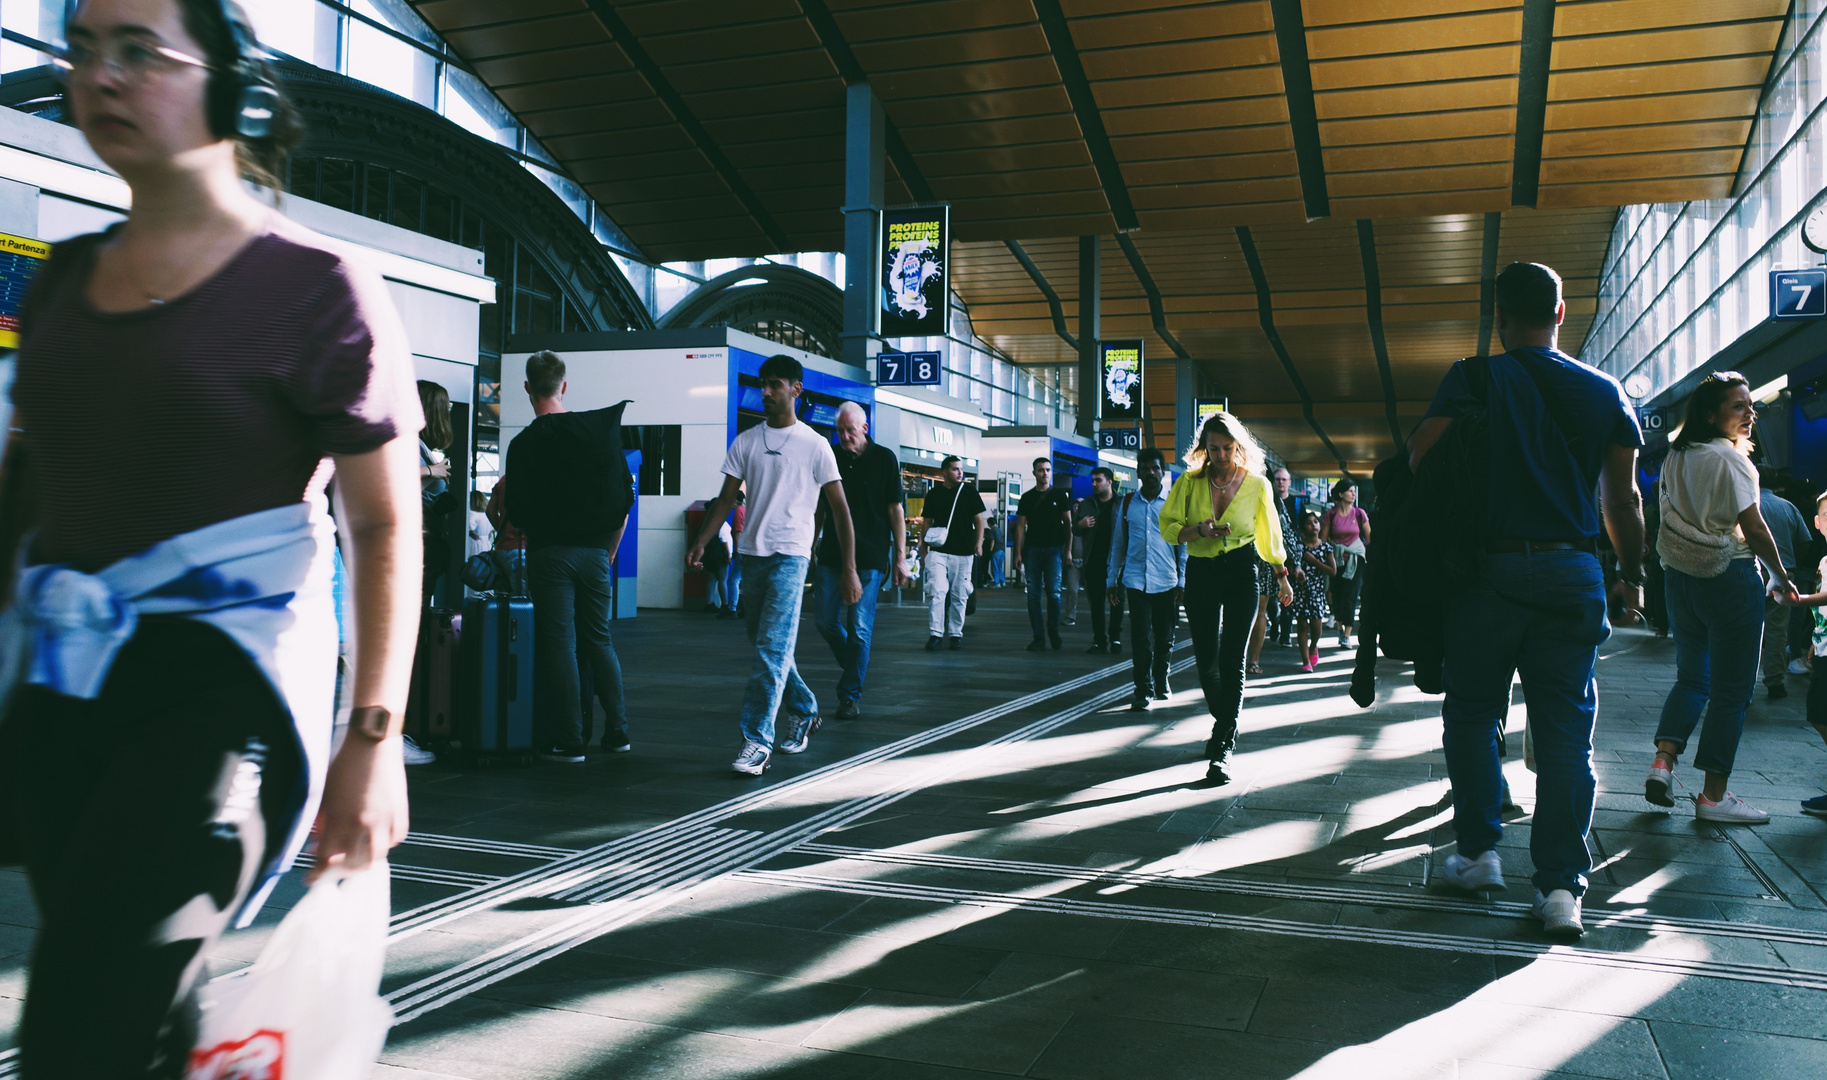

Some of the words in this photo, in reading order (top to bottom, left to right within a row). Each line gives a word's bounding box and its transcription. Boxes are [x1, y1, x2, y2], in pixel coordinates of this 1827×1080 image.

[889, 221, 939, 232] PROTEINS
[8, 239, 46, 255] Partenza
[1791, 285, 1812, 311] 7
[886, 362, 899, 380] 7
[918, 362, 932, 380] 8
[1643, 415, 1662, 429] 10
[1105, 435, 1114, 447] 9
[1123, 434, 1137, 446] 10
